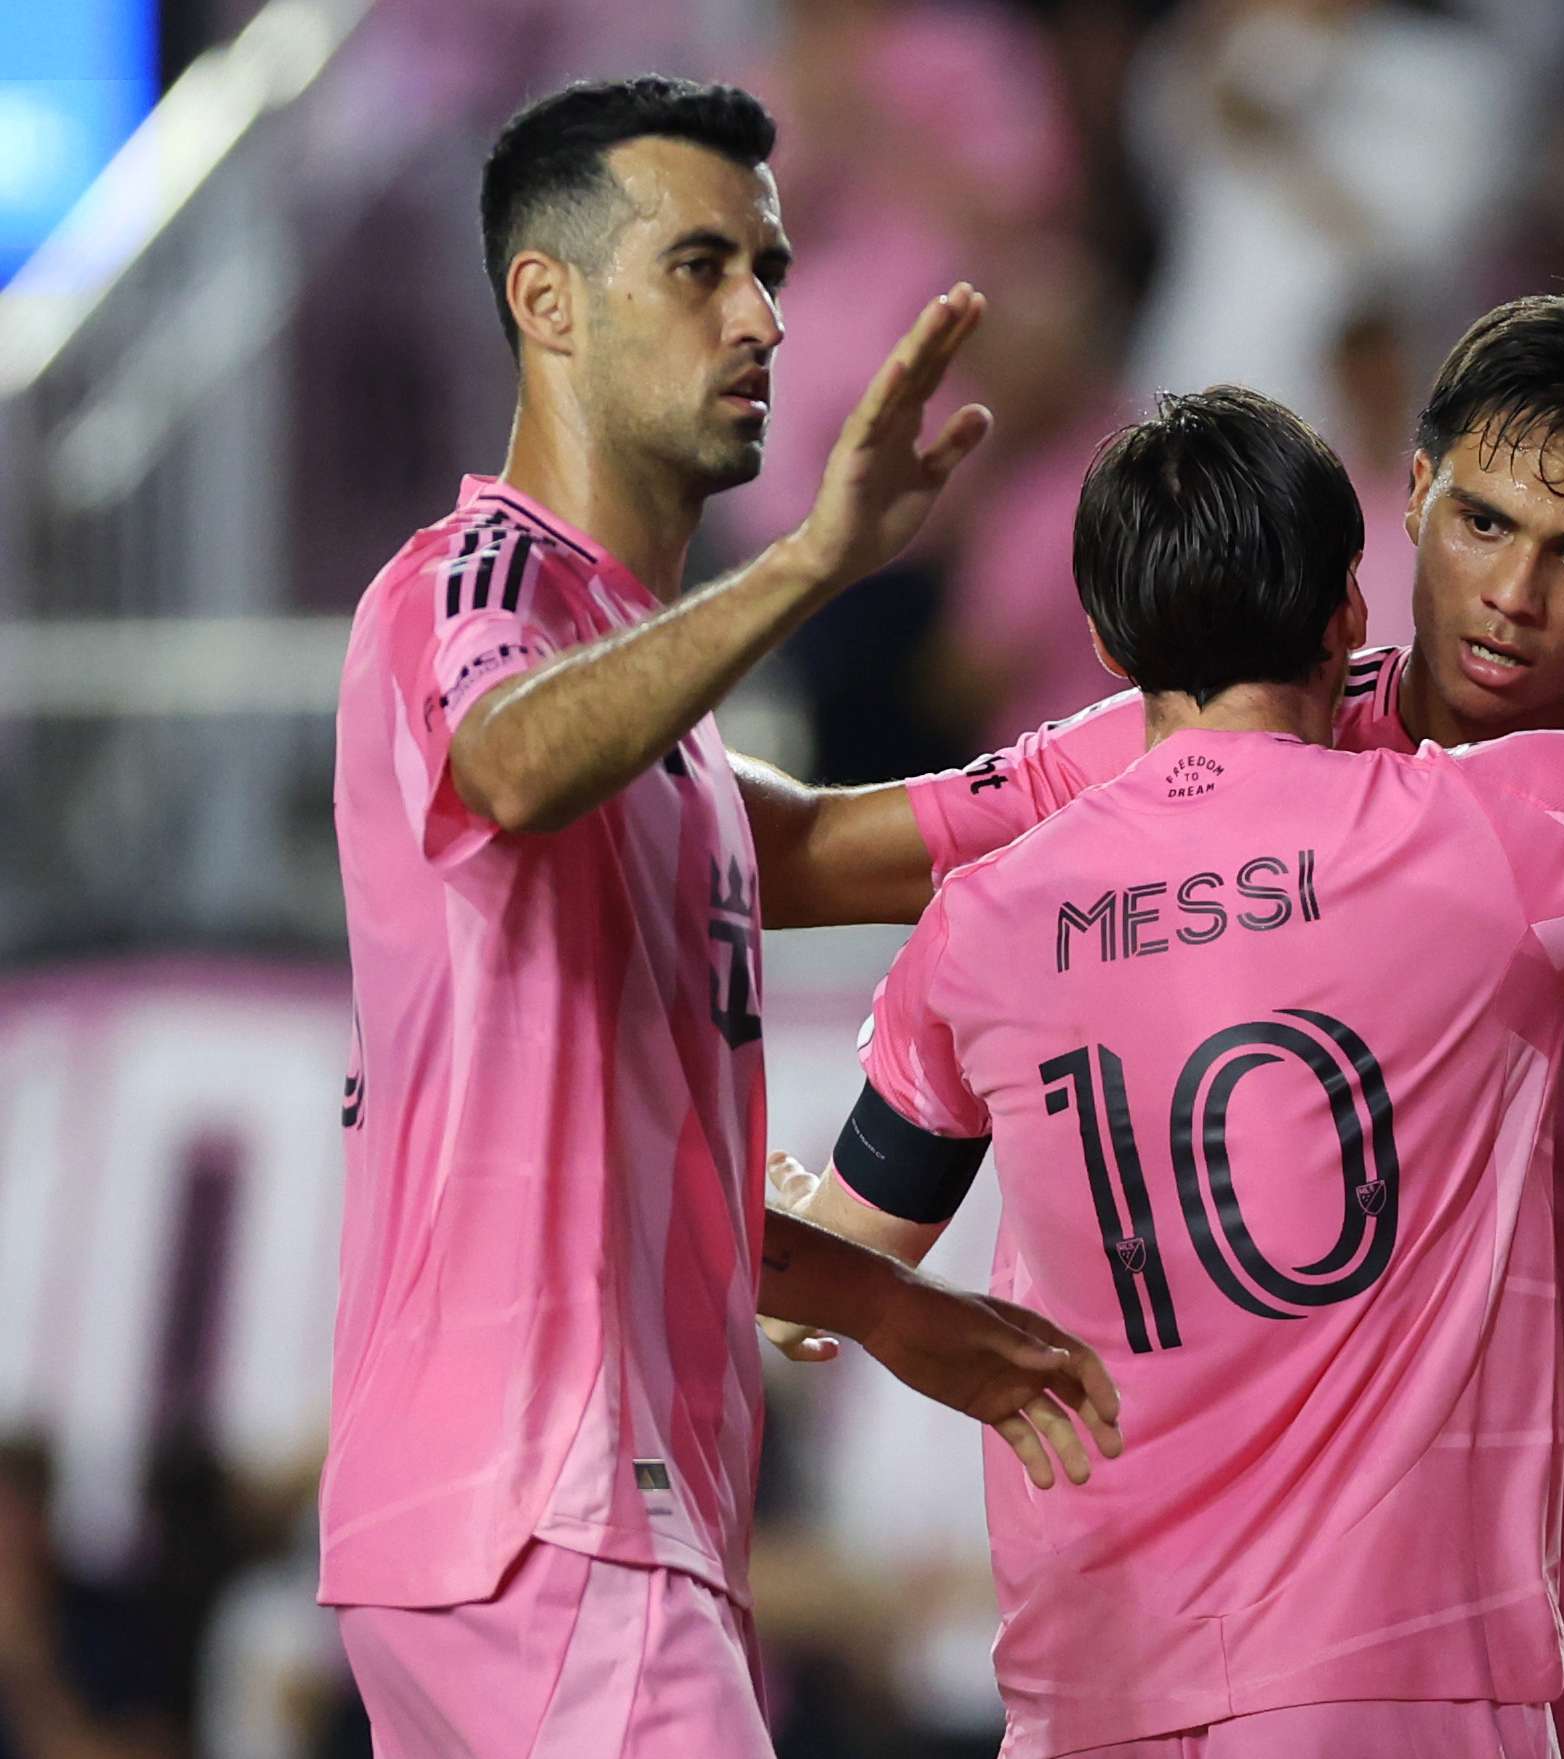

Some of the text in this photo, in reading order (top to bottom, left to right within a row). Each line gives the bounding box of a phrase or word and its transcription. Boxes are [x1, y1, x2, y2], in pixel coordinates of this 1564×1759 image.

[1165, 755, 1225, 784] FREEDOM
[1184, 772, 1199, 782] TO
[1167, 783, 1215, 798] DREAM
[1055, 849, 1322, 973] MESSI
[1038, 1008, 1400, 1355] 10
